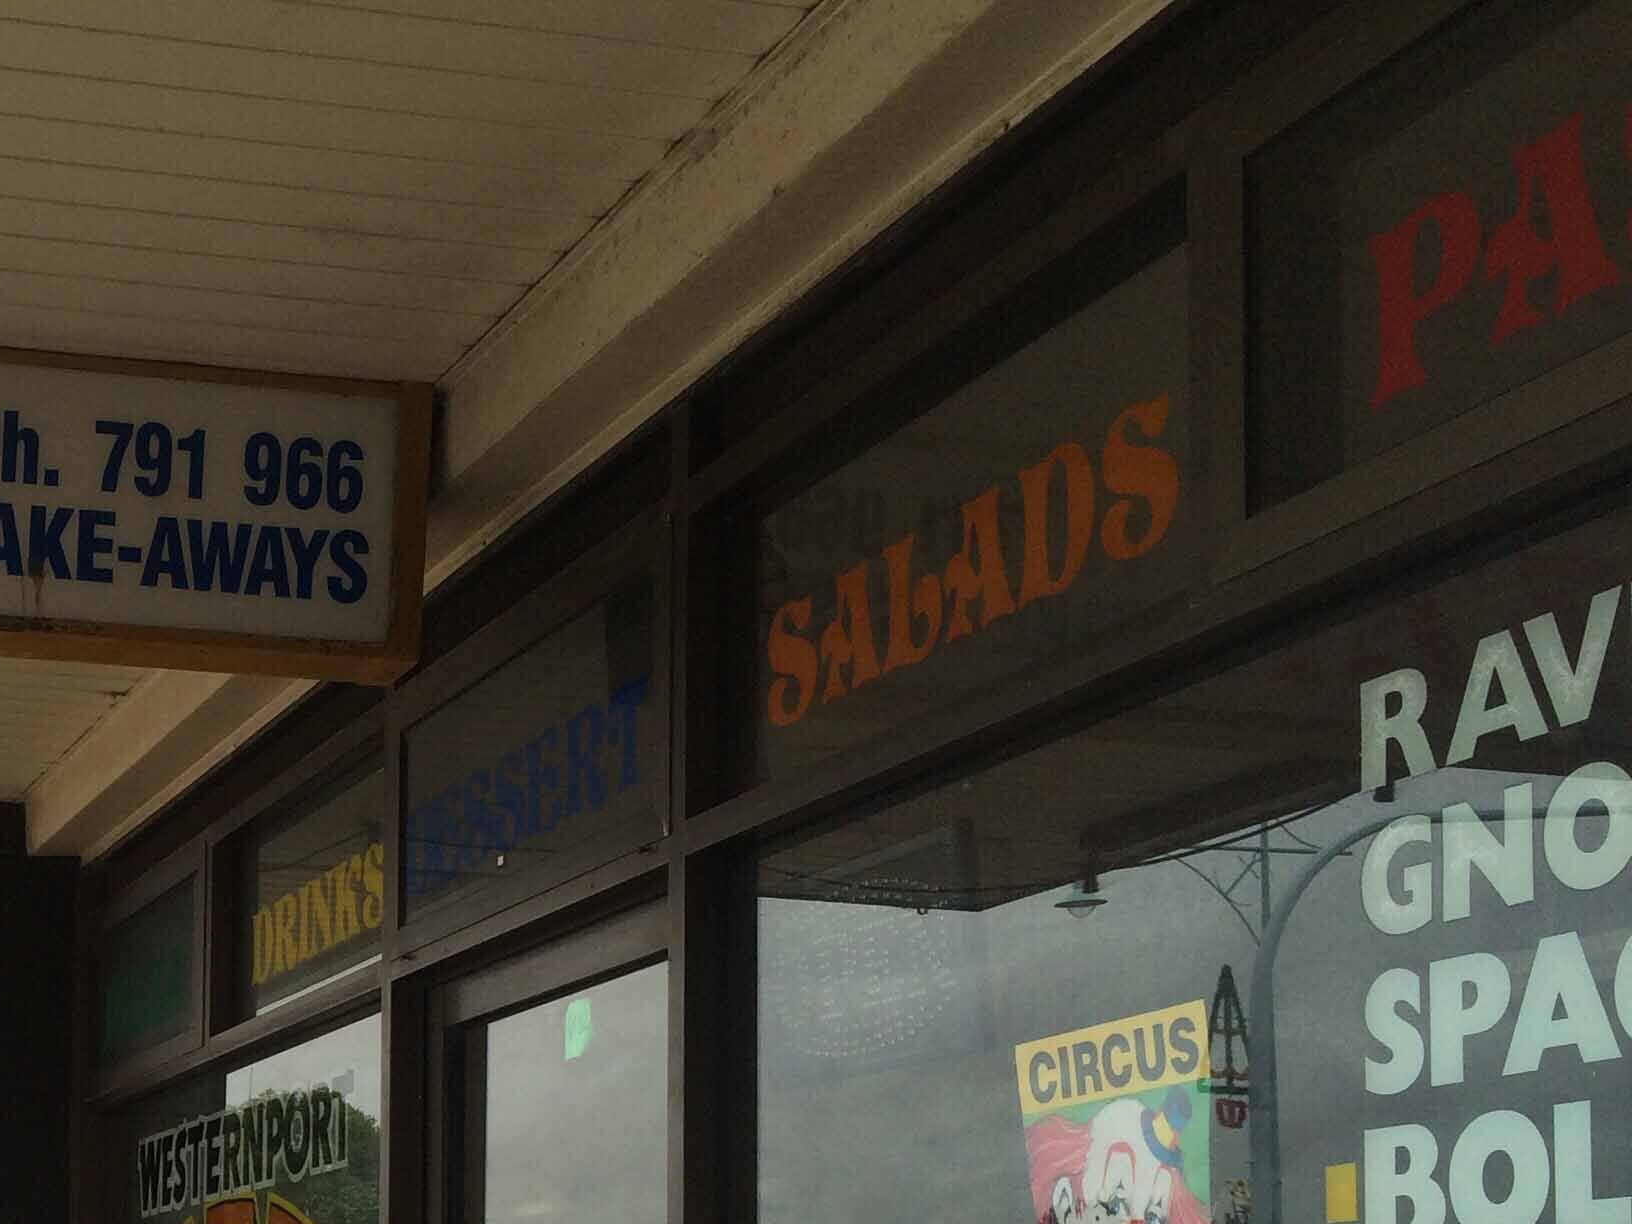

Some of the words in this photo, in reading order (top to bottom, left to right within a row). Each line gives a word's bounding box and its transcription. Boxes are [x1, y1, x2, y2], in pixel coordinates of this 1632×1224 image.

[1371, 104, 1632, 413] PA
[95, 420, 206, 500] 791
[244, 432, 364, 513] 966
[767, 391, 1183, 727] SALADS
[1360, 582, 1632, 793] RAV
[1028, 1018, 1200, 1105] CIRCUS
[1364, 928, 1632, 1096] SPA
[137, 1069, 354, 1217] WESTERNPORT
